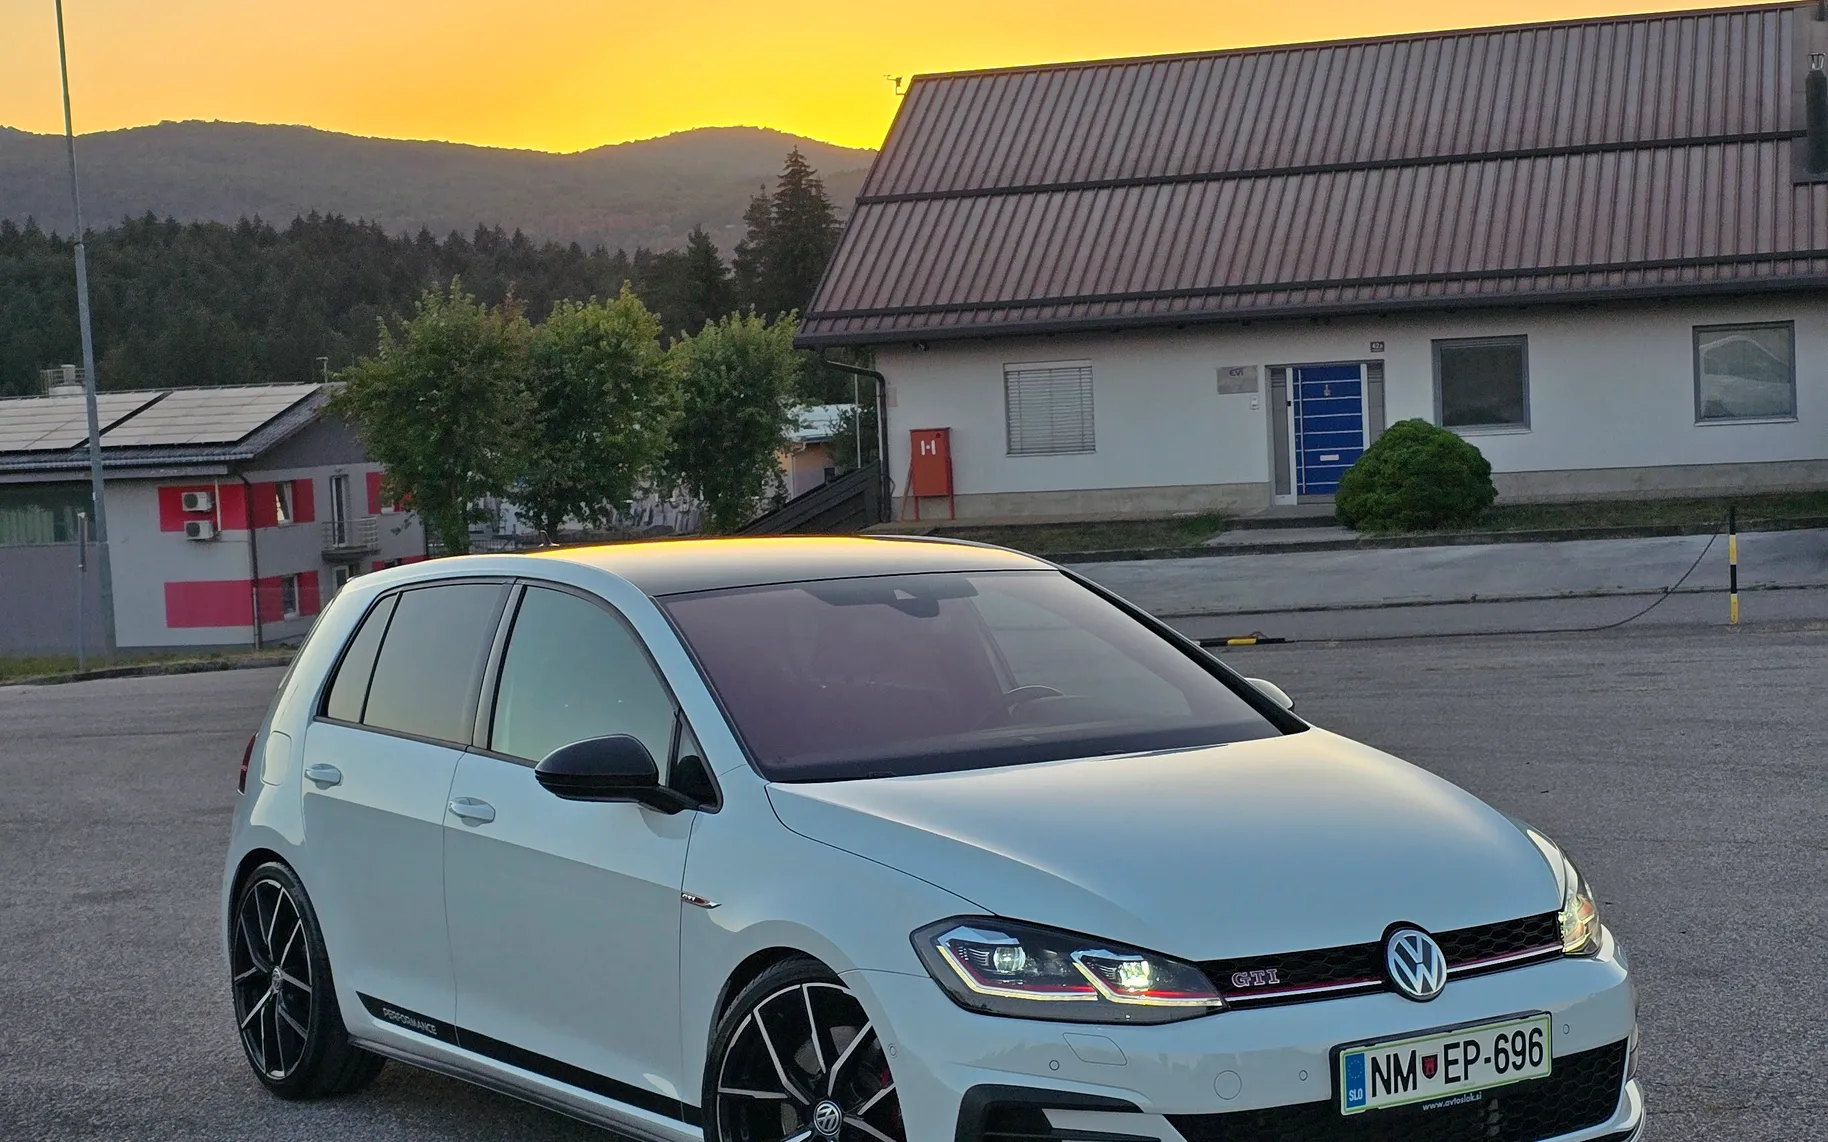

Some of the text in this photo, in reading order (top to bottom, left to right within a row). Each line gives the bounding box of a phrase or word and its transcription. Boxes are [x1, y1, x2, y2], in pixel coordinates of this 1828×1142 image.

[1231, 969, 1280, 988] GTI
[382, 1007, 438, 1035] PERFORMANCE
[1348, 1087, 1363, 1102] SLO
